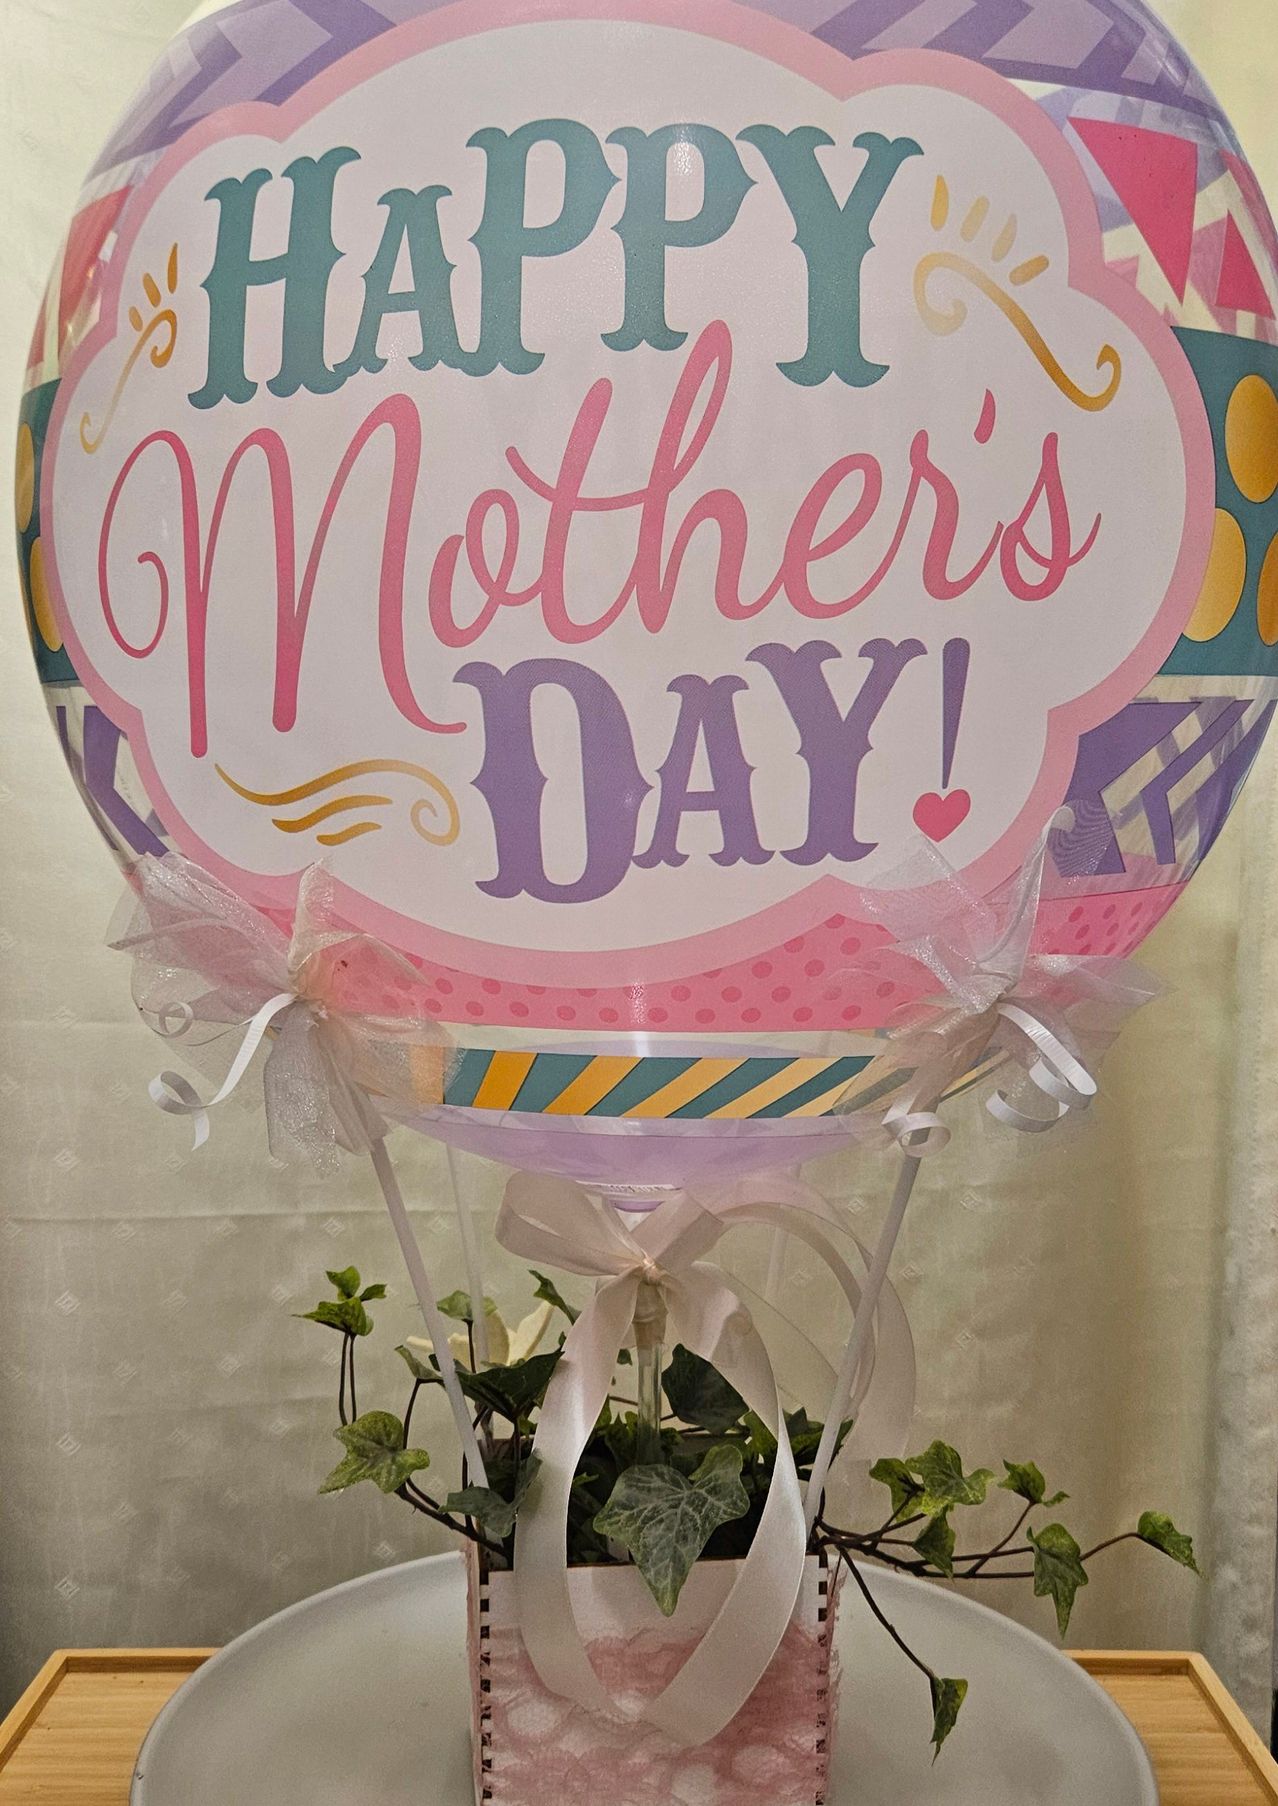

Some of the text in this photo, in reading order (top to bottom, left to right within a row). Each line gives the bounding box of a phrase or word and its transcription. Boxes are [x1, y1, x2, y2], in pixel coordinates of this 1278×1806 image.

[187, 117, 925, 410] HAPPY
[98, 319, 1102, 759] Mother's
[452, 637, 972, 904] DAY!
